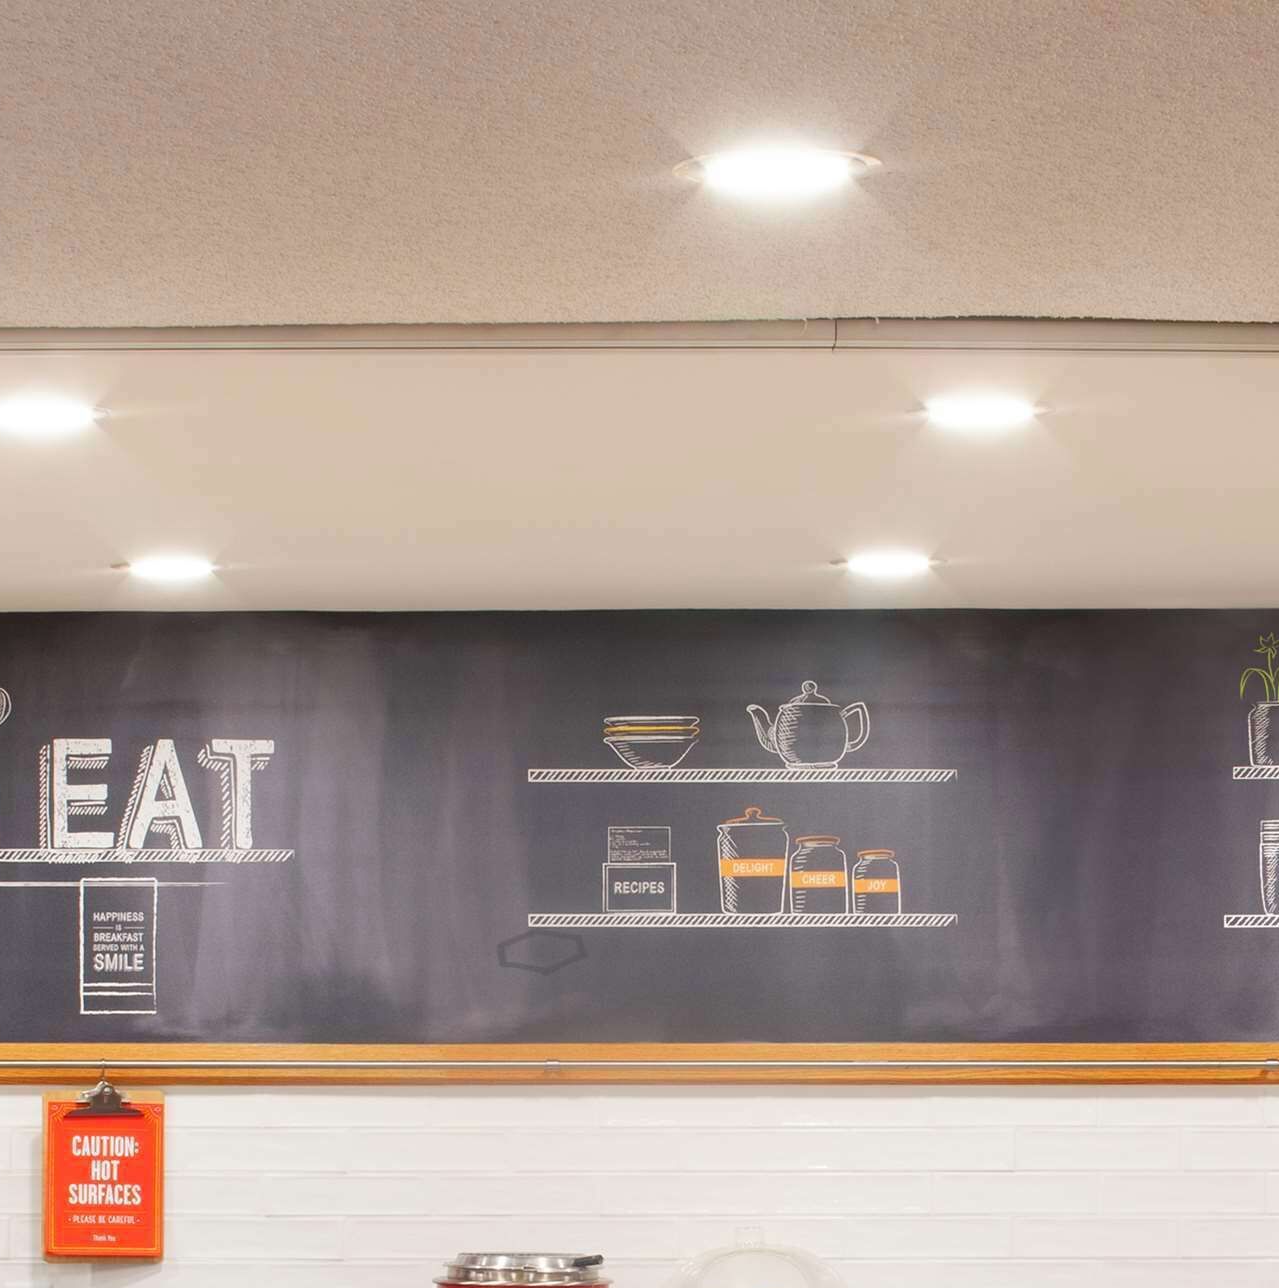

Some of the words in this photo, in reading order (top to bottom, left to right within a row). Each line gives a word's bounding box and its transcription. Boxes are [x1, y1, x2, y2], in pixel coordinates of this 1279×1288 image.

[40, 738, 275, 850] EAT
[732, 863, 774, 873] DELIGHT
[801, 874, 836, 885] CHEER
[868, 880, 887, 890] JOY
[614, 881, 665, 894] RECIPES
[93, 912, 144, 922] HAPPINESS
[94, 932, 144, 942] BREAKFAST
[94, 953, 144, 972] SMILE
[72, 1135, 139, 1157] CAUTION:
[91, 1160, 120, 1181] HOT
[68, 1184, 142, 1205] SURFACES
[72, 1215, 96, 1224] PLEASE
